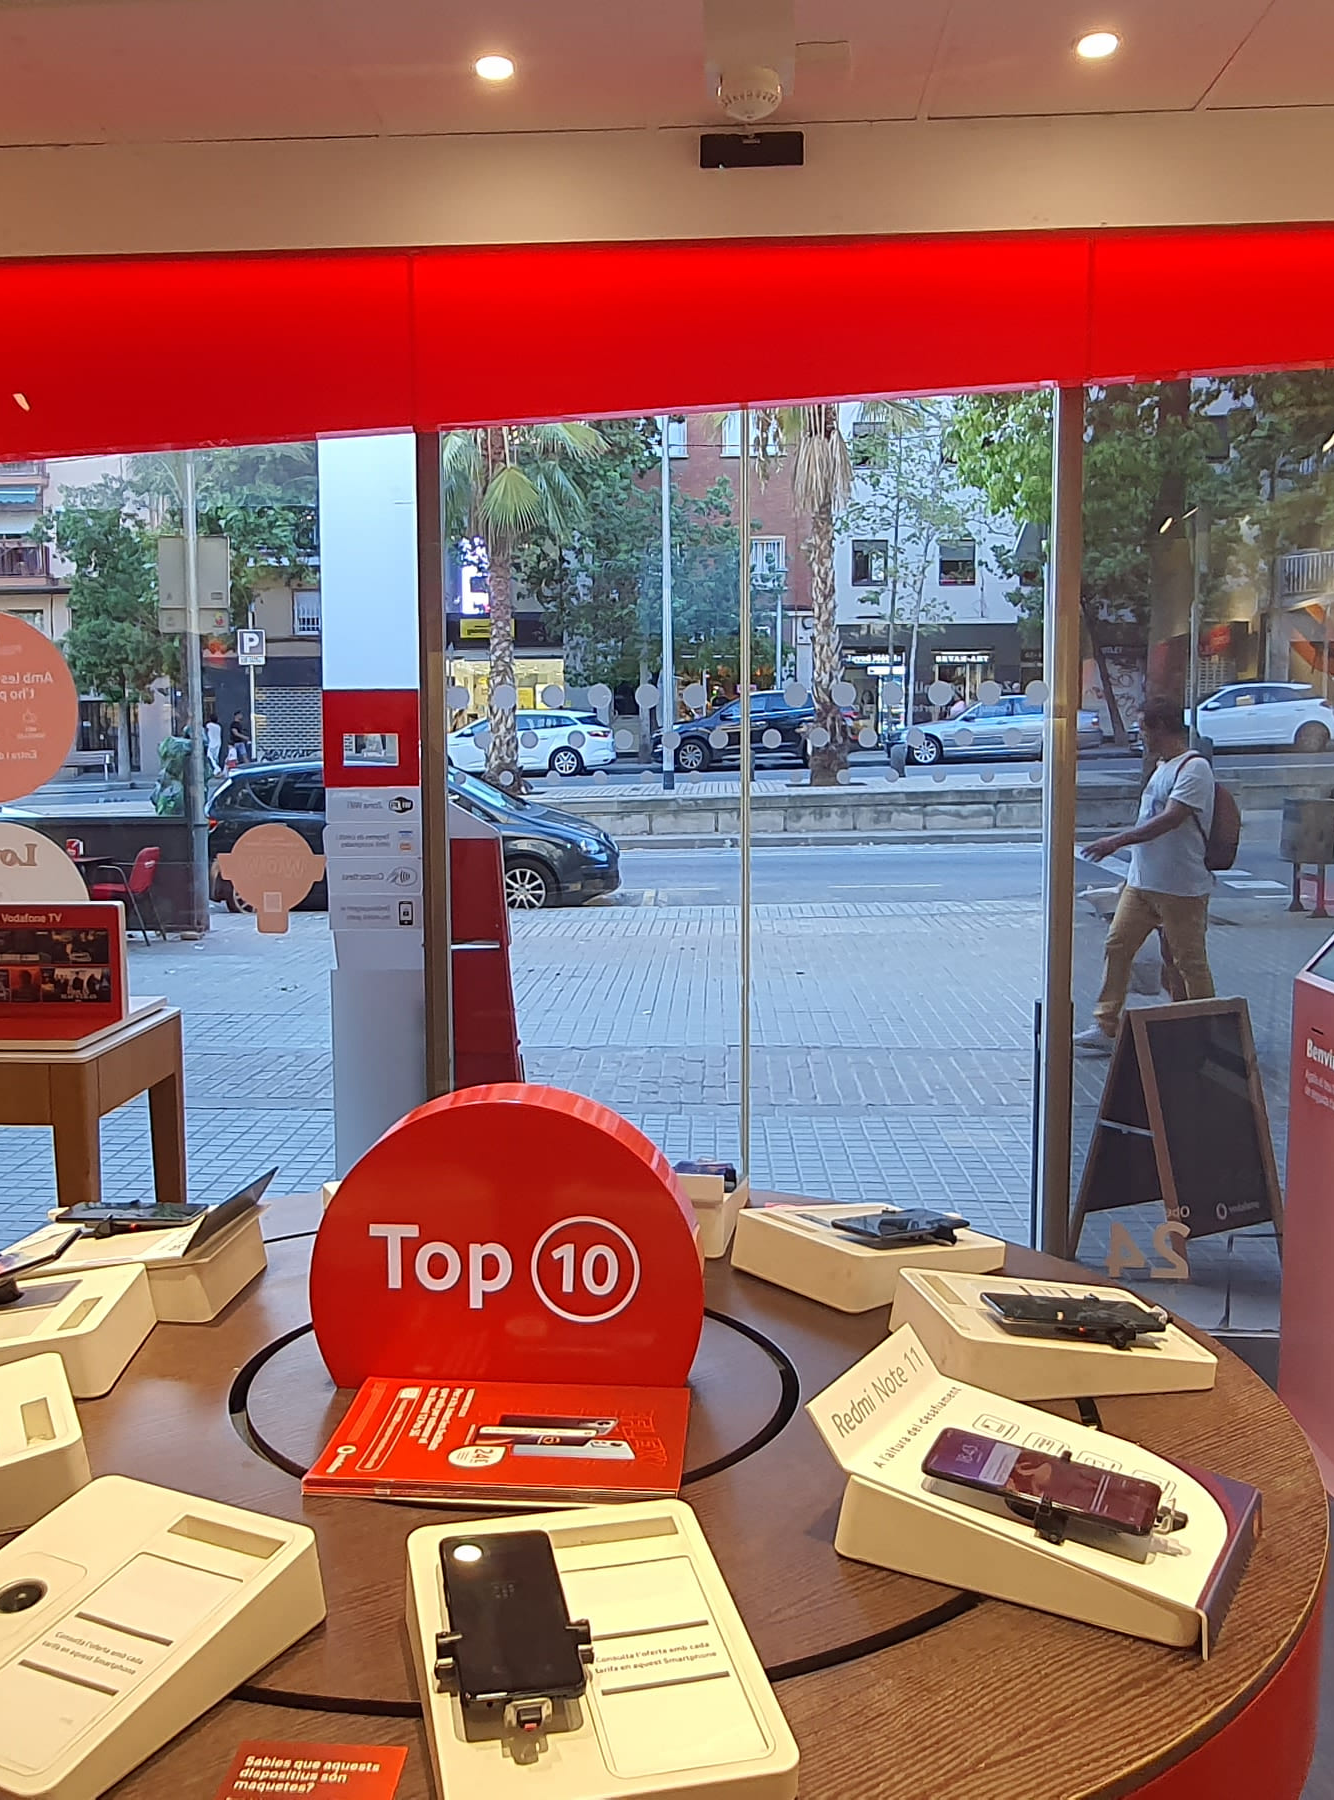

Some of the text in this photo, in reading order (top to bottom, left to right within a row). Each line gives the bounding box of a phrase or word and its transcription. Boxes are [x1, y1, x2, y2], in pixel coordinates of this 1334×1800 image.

[243, 633, 260, 654] P
[1, 913, 47, 924] Vodafone
[49, 913, 63, 923] TV
[369, 1223, 620, 1309] Top 10
[831, 1347, 924, 1438] Redmi Note 11
[907, 1424, 923, 1437] del
[244, 1755, 380, 1773] Sabies que aquests
[239, 1767, 319, 1781] dispositius
[233, 1780, 315, 1793] maquetes?
